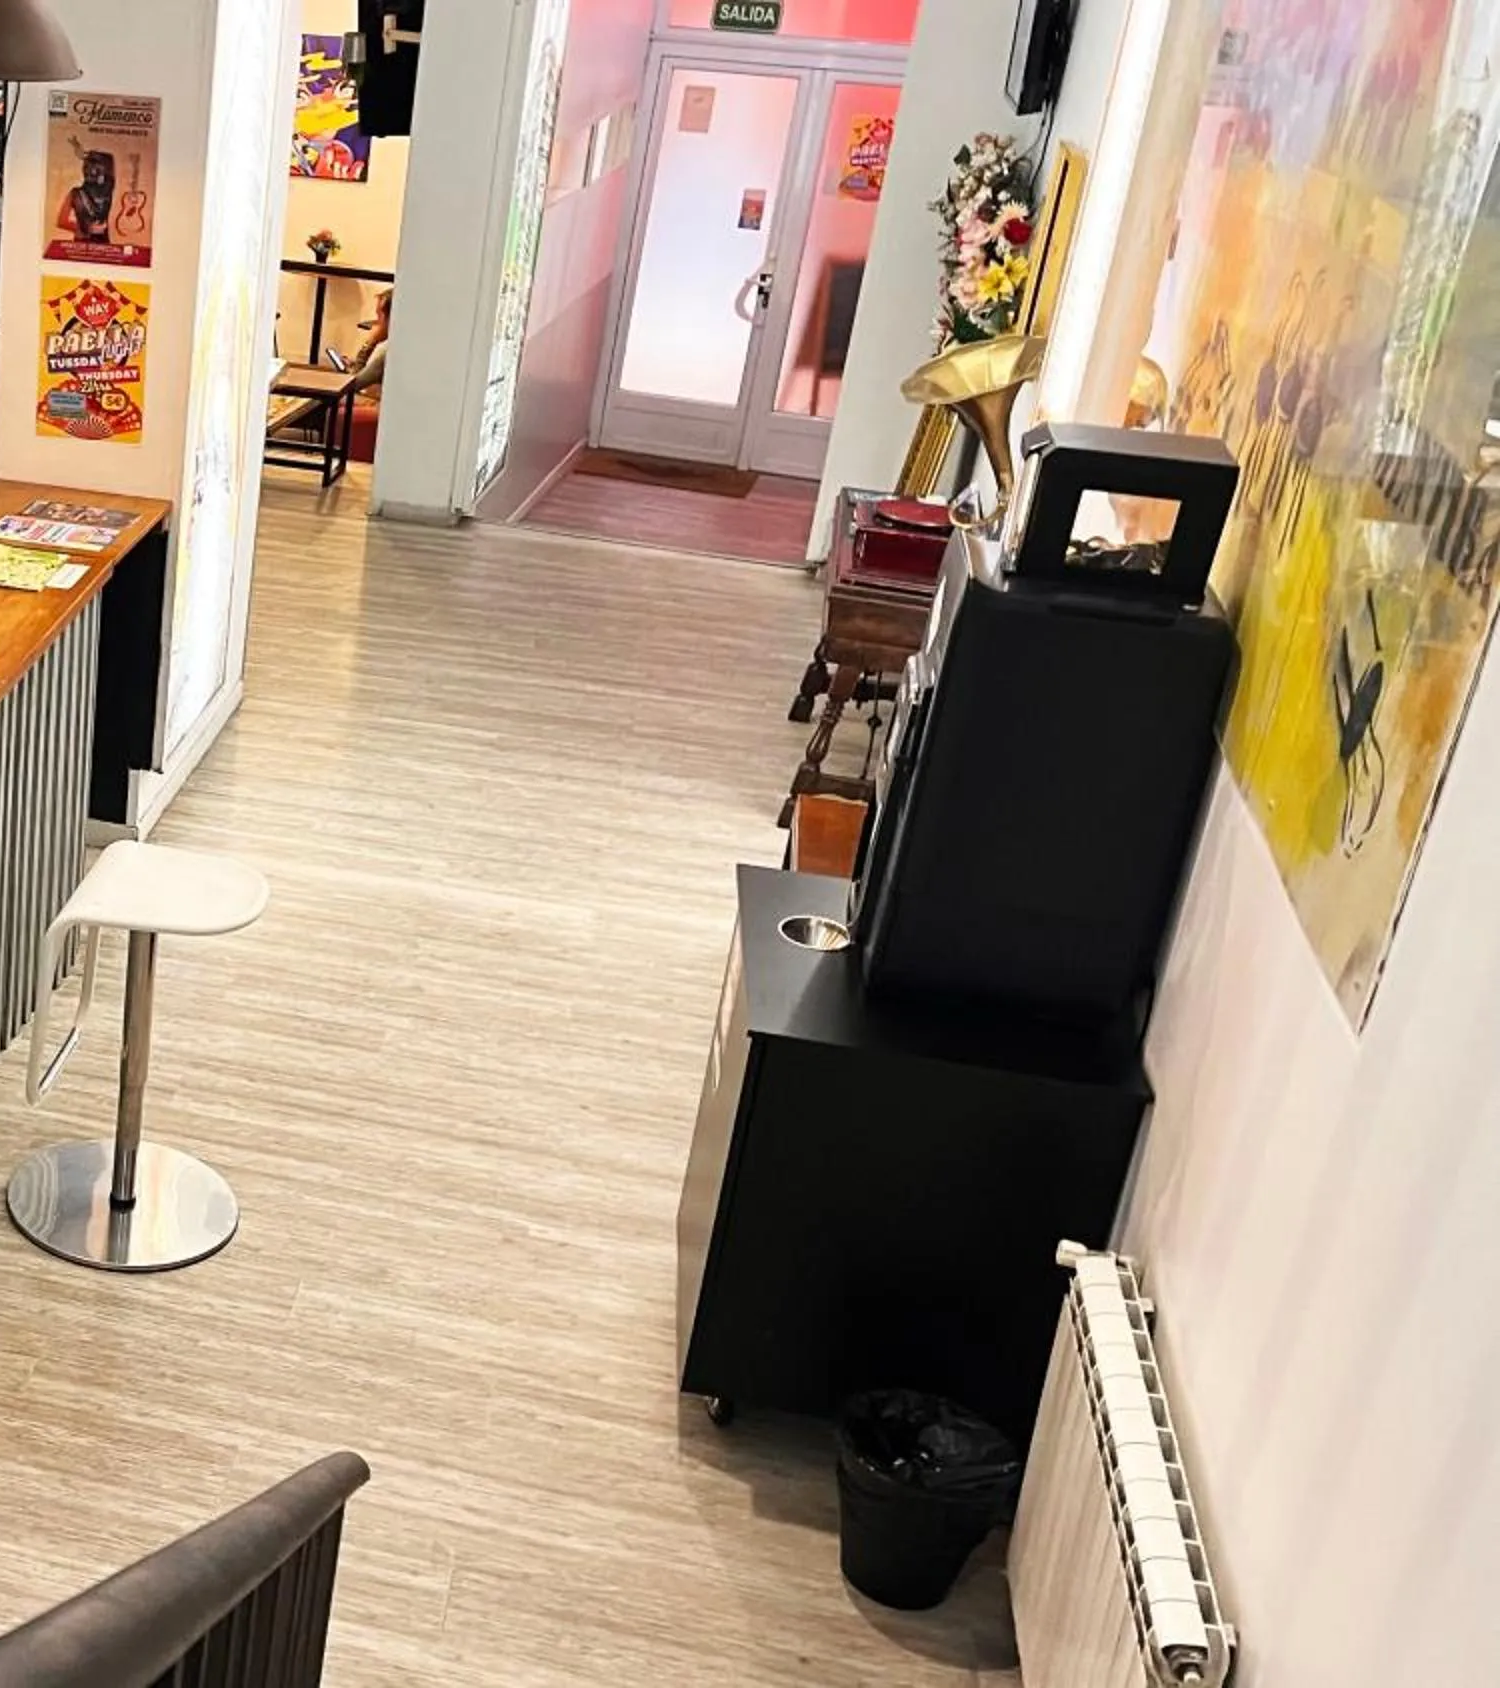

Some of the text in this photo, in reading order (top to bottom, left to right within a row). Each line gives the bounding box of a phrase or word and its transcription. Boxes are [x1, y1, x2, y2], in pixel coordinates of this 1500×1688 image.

[719, 3, 775, 25] SALIDA
[49, 356, 104, 369] TUESDAY
[78, 369, 138, 381] THURSDAY
